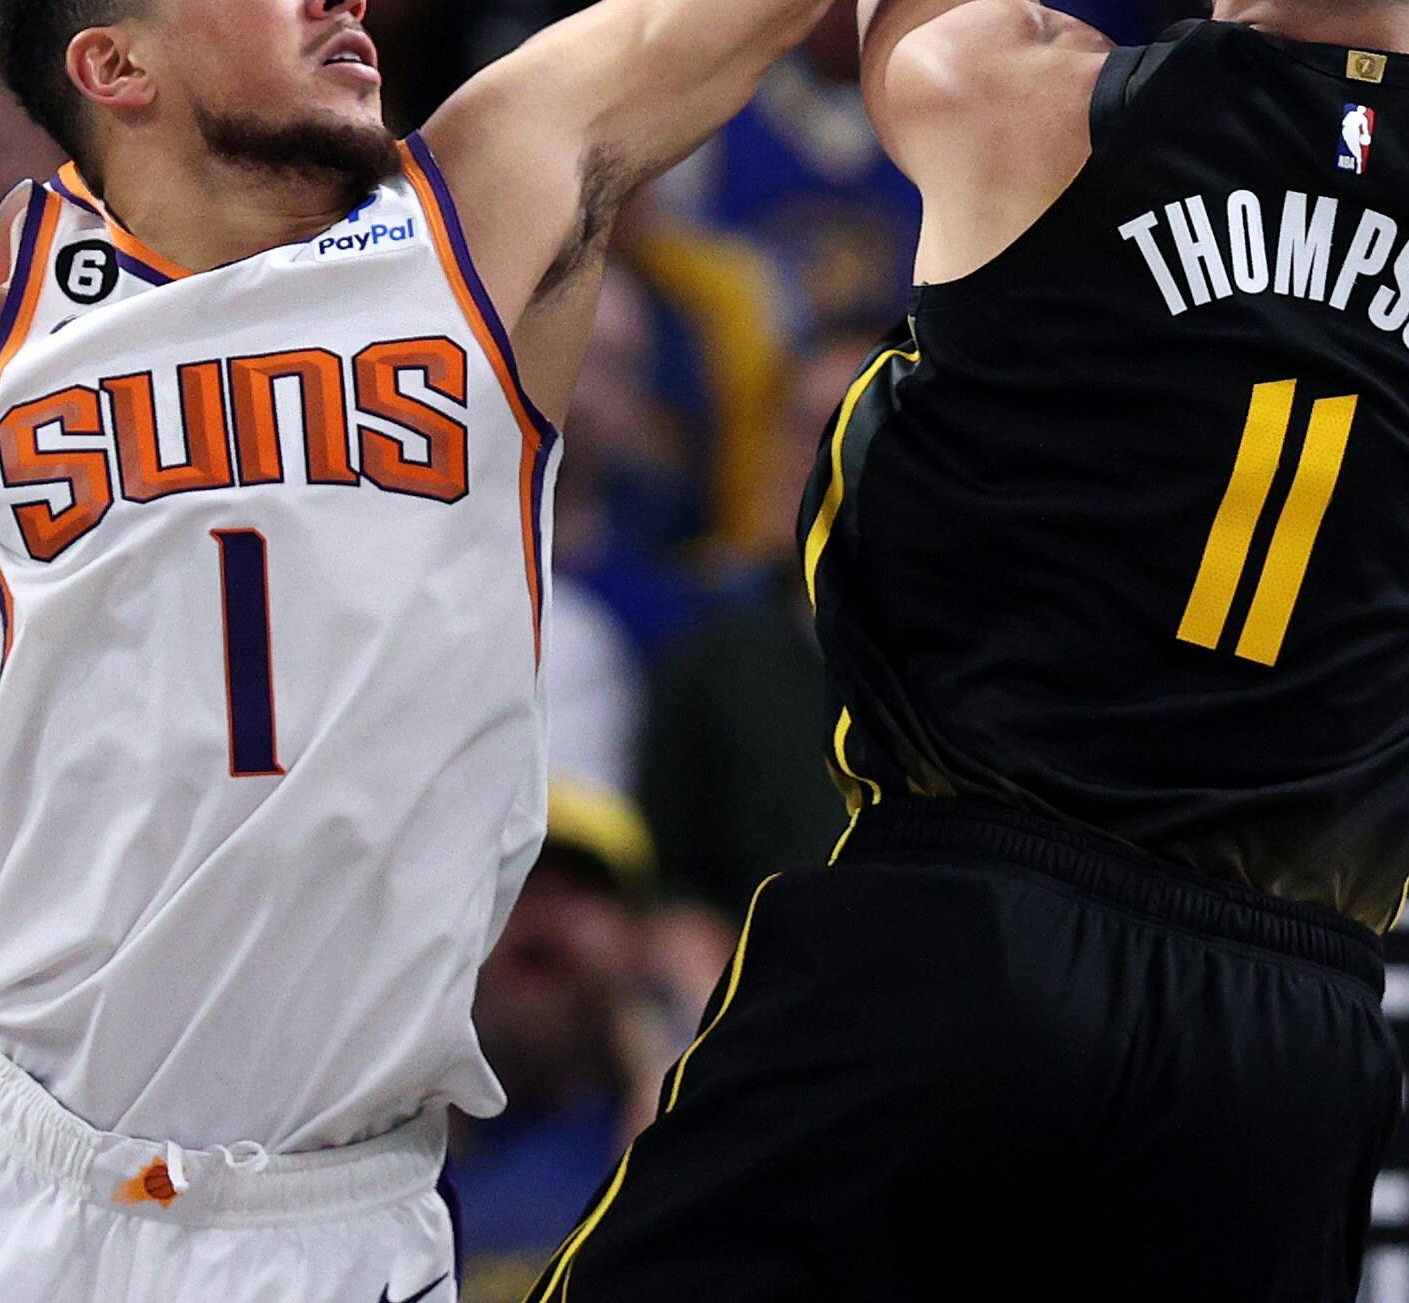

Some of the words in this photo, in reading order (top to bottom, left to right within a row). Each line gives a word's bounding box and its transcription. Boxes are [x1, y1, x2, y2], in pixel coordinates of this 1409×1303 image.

[67, 249, 107, 297] 6
[318, 217, 414, 255] PayPal
[1176, 378, 1359, 668] 11
[209, 527, 286, 777] 1
